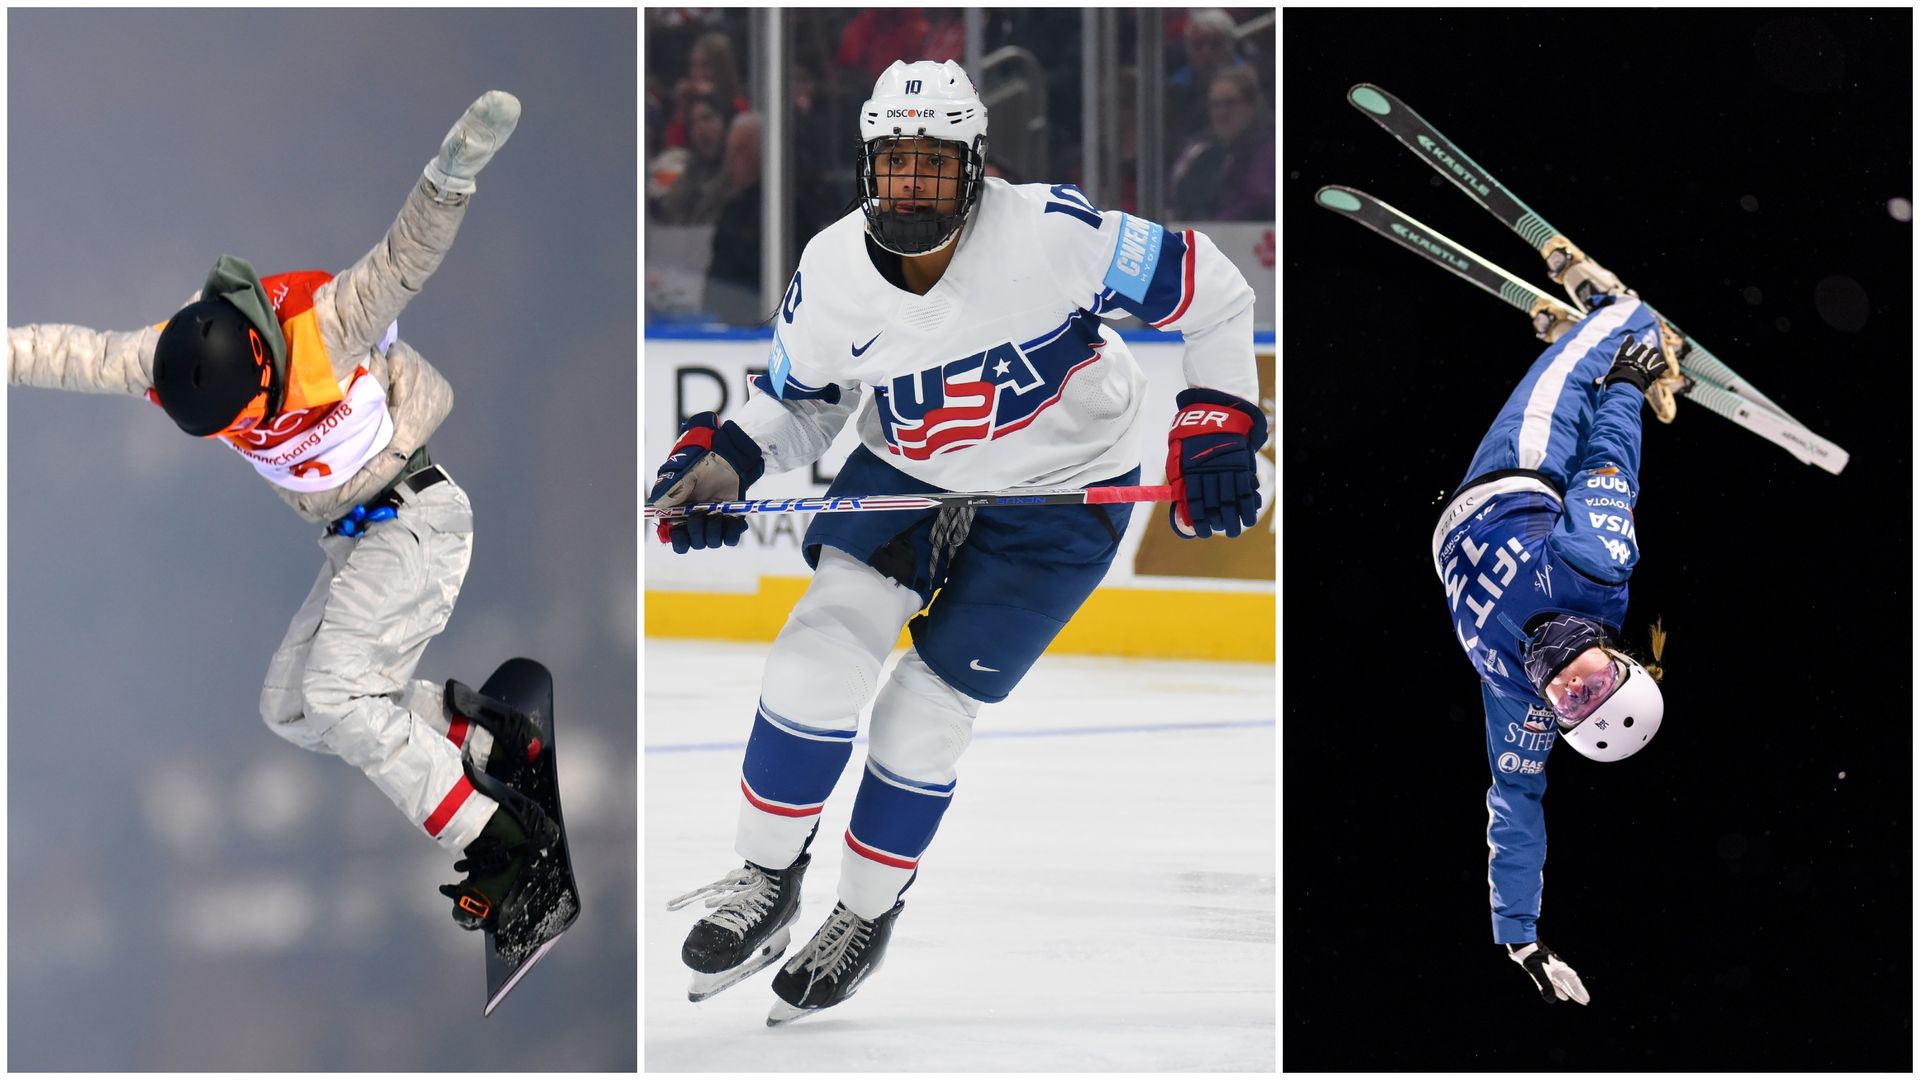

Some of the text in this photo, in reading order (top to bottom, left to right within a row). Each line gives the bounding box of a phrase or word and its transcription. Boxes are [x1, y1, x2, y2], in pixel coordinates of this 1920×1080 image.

[904, 79, 923, 95] 10
[886, 109, 936, 118] DISCOVER
[892, 340, 1038, 461] USA
[317, 402, 353, 437] 2018
[1584, 497, 1632, 512] TOYOTA
[1588, 511, 1639, 551] VISA
